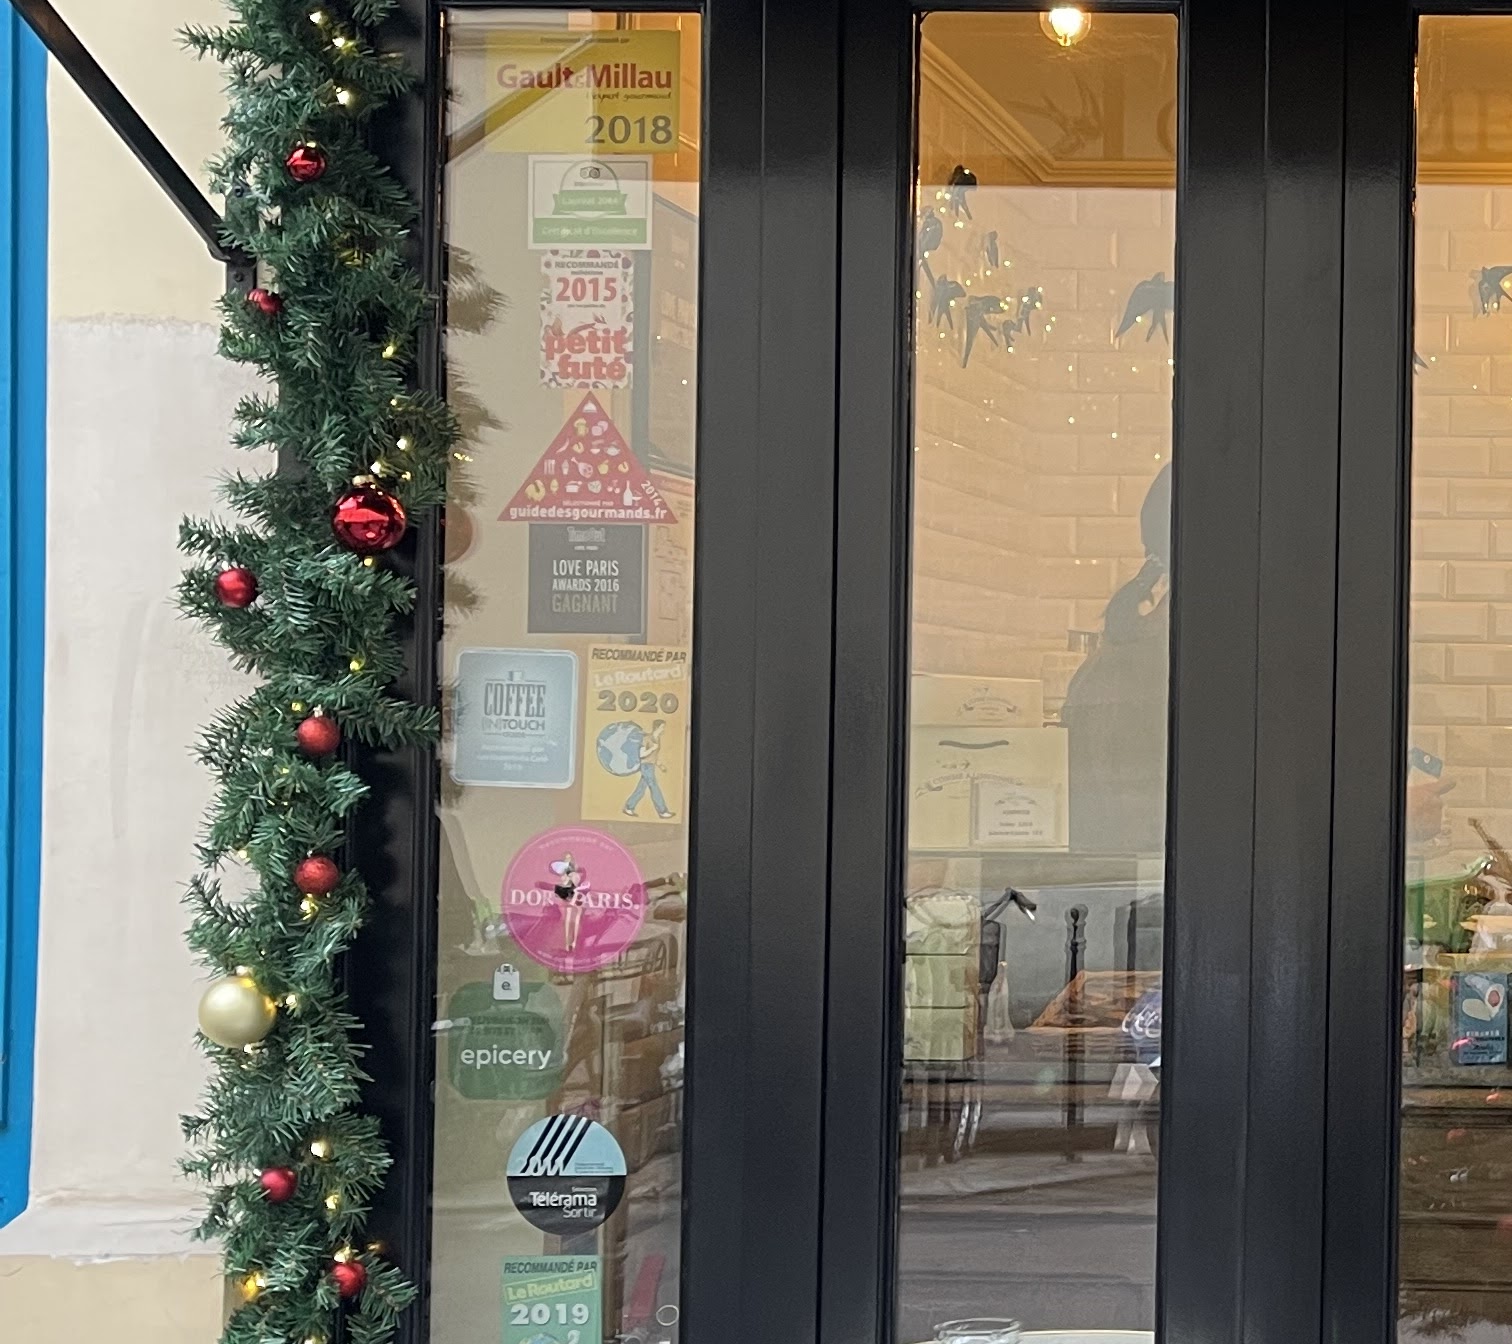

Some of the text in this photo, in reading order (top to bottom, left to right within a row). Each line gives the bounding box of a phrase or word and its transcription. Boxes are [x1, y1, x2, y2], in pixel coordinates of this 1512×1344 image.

[585, 115, 672, 144] 2018
[555, 261, 618, 269] RECOMMANDÉ
[556, 277, 617, 302] 2015
[545, 328, 629, 360] petit
[557, 354, 627, 380] futé
[510, 505, 667, 520] guidedesgourmands.fr
[553, 559, 619, 577] LOVE PARIS
[552, 578, 620, 592] AWARDS 2016
[552, 593, 619, 614] GAGNANT
[592, 647, 687, 664] RECOMMANDÉ PAR
[484, 682, 546, 717] COFFEE
[596, 689, 679, 714] 2020
[460, 1044, 552, 1069] epicery
[529, 1191, 597, 1206] Télérama
[563, 1207, 598, 1218] Sortir
[504, 1259, 598, 1274] RECOMMANDÉ PAR
[510, 1303, 589, 1325] 2019
